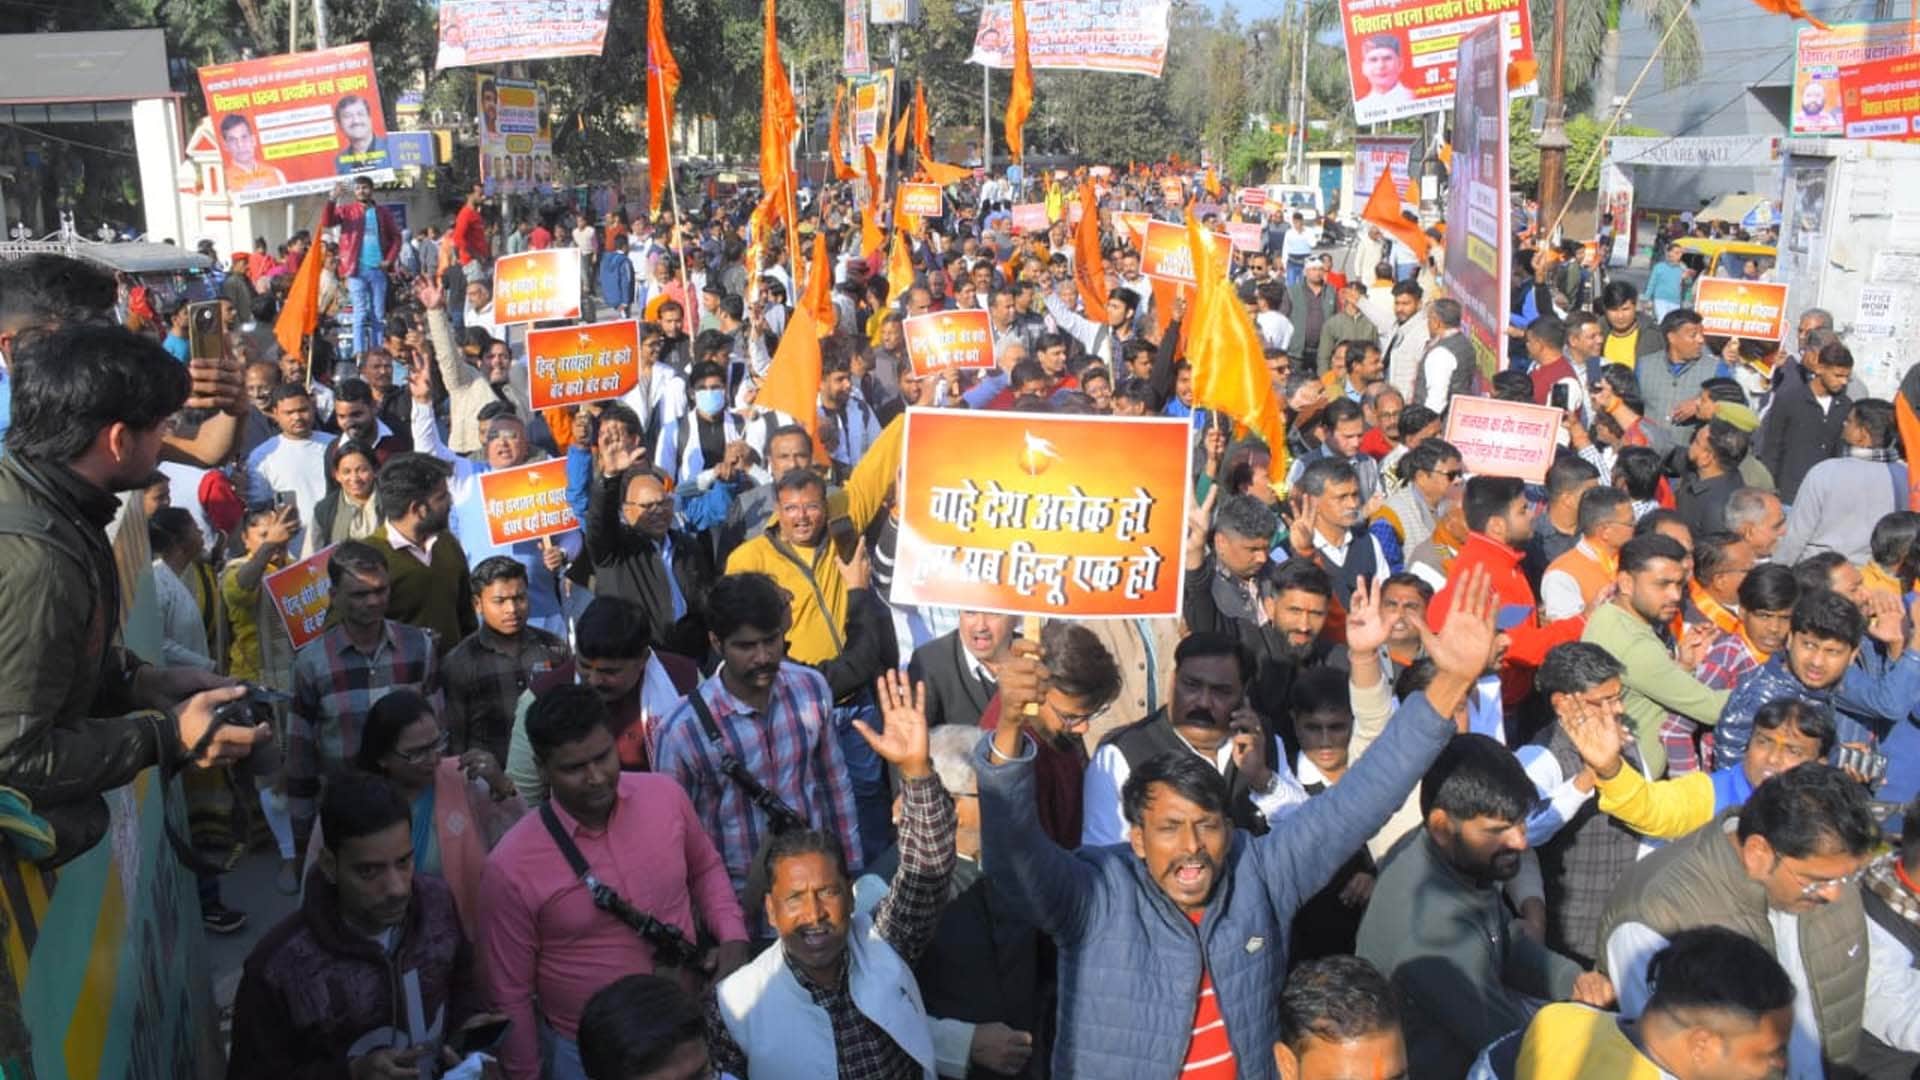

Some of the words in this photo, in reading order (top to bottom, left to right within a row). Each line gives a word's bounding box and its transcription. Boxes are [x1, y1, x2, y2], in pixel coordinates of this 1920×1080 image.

[982, 480, 1031, 530] देश
[1032, 485, 1117, 533] अनेक
[1117, 487, 1156, 542] हो
[960, 546, 1008, 587] सब
[1007, 540, 1071, 606] हिन्दू
[1073, 555, 1128, 594] एक
[1124, 546, 1166, 600] हो
